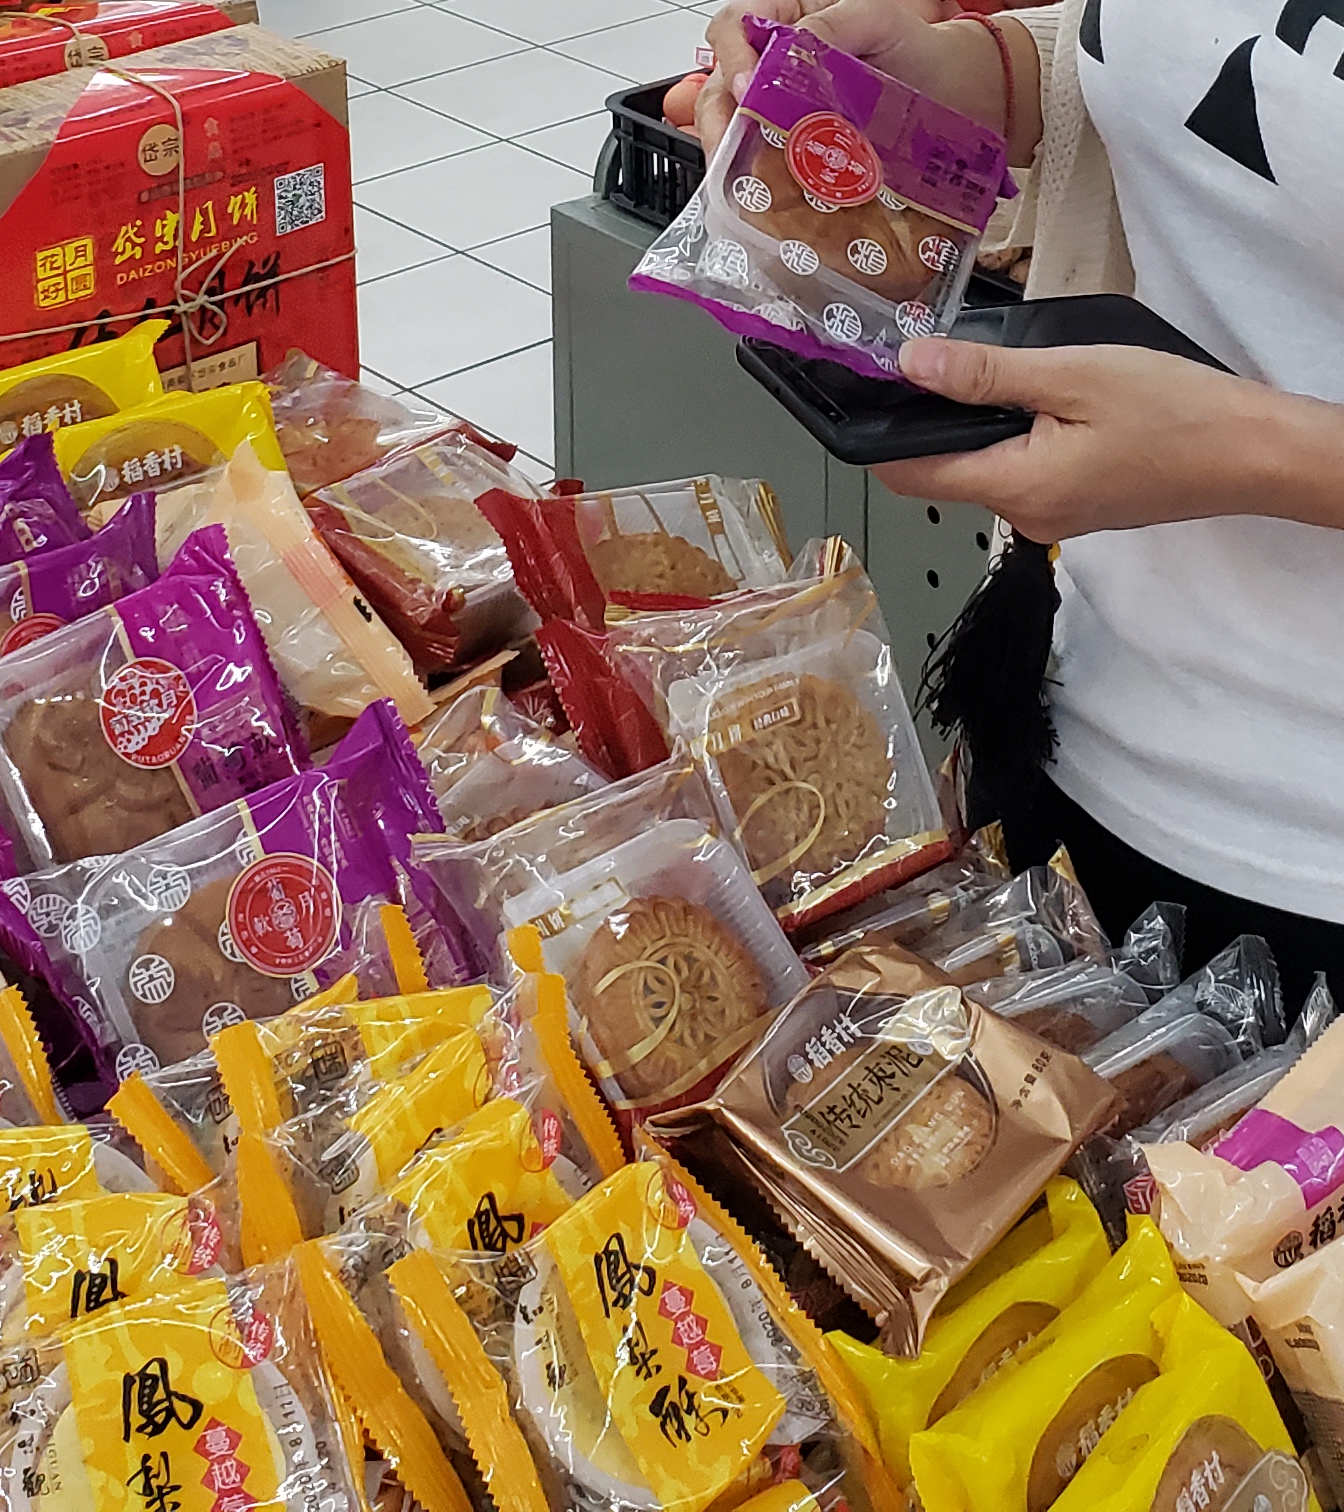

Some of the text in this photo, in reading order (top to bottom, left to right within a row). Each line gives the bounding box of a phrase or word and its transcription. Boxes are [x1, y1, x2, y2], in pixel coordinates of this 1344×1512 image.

[22, 399, 83, 439] 稻香村
[121, 445, 183, 485] 稻香村
